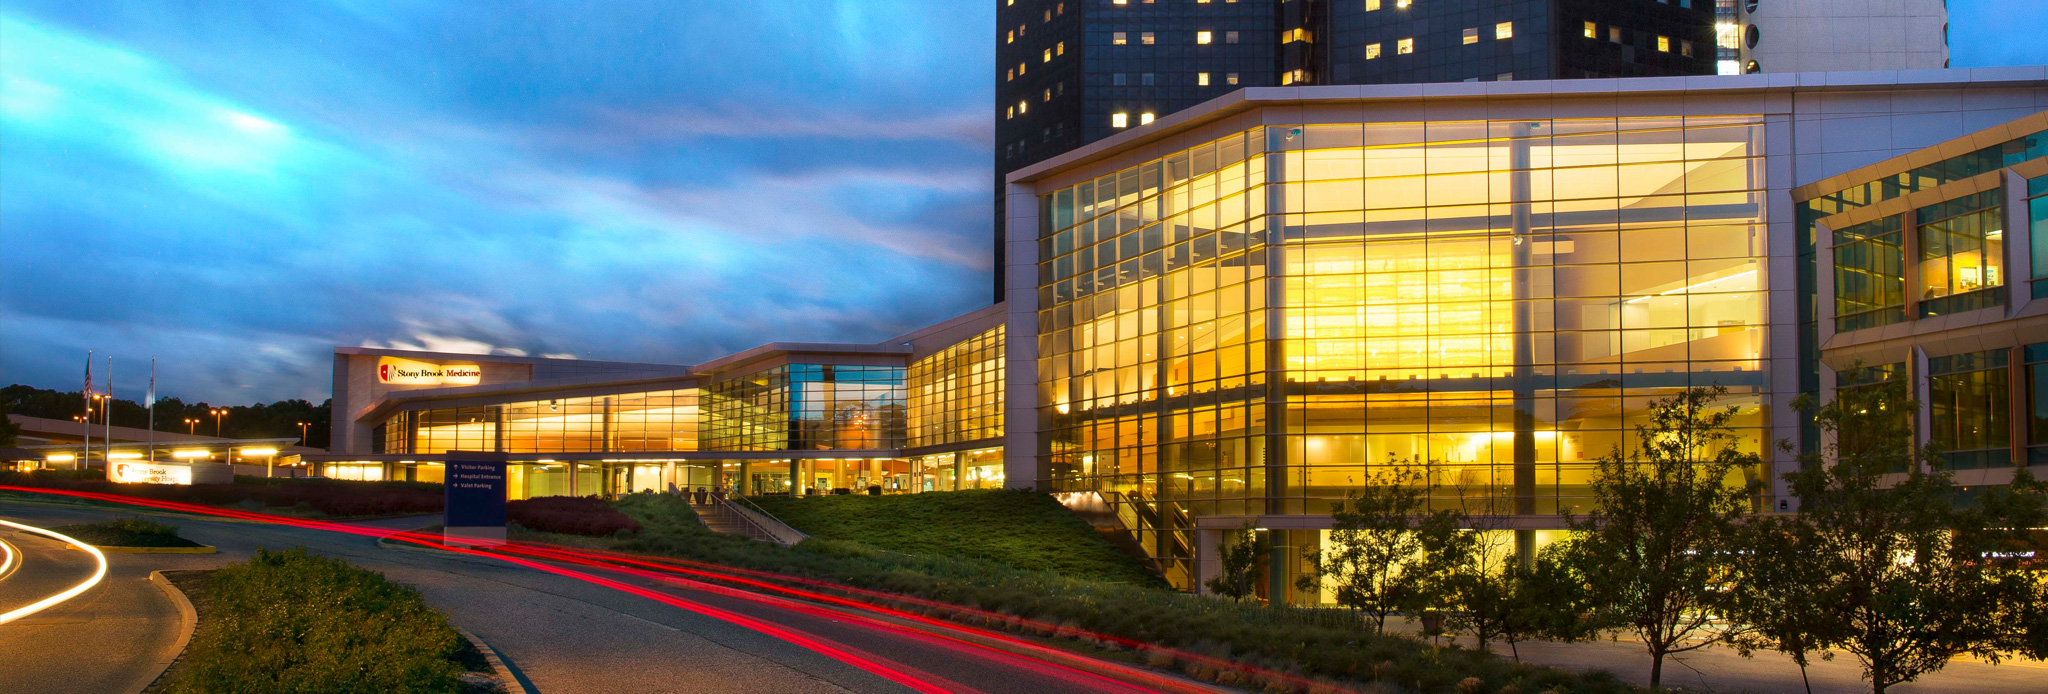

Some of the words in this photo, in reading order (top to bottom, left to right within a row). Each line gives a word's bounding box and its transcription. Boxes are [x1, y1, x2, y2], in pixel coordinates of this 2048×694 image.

[397, 369, 420, 378] Stony
[421, 369, 443, 377] Brook
[446, 369, 481, 377] Medicine
